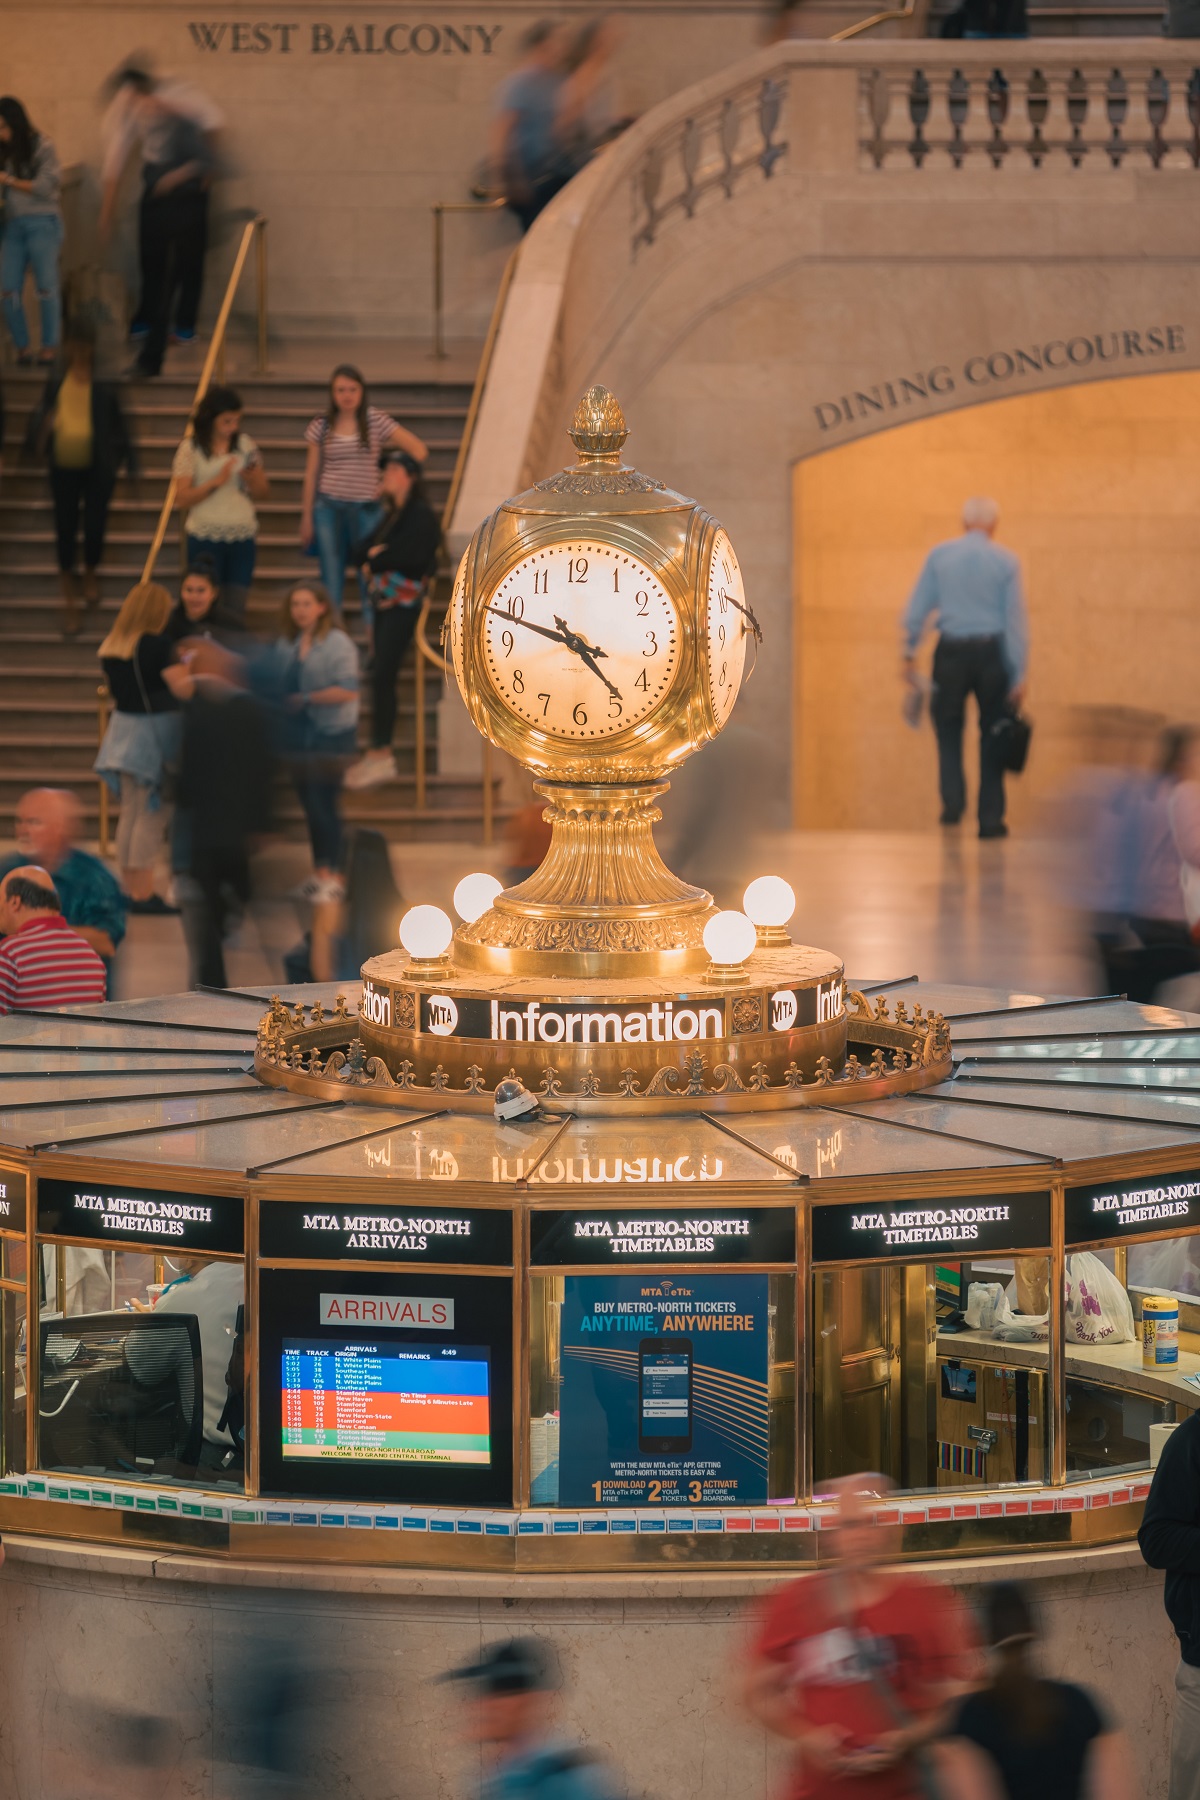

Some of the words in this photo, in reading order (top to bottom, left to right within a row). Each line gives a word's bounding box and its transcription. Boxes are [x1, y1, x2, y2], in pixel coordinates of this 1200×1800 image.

[188, 22, 298, 52] WEST
[311, 23, 502, 55] BALCONY
[812, 366, 955, 431] DINING
[964, 325, 1186, 386] CONCOURSE
[534, 570, 548, 594] 11
[567, 558, 588, 583] 12
[613, 568, 620, 593] 1
[508, 596, 524, 622] 10
[636, 591, 649, 616] 2
[502, 631, 513, 657] 9
[642, 631, 658, 656] 3
[513, 670, 525, 693] 8
[635, 669, 650, 692] 4
[538, 693, 550, 716] 7
[573, 702, 588, 725] 6
[608, 695, 623, 718] 5
[490, 1000, 722, 1042] Information
[74, 1194, 104, 1210] MTA
[107, 1198, 212, 1222] METRO-NORTH
[1092, 1195, 1120, 1212] MTA
[1117, 1201, 1189, 1224] TIMETABLES
[101, 1214, 184, 1236] TIMETABLES
[303, 1215, 340, 1230] MTA
[344, 1216, 470, 1235] METRO-NORTH
[574, 1222, 613, 1237] MTA
[617, 1220, 749, 1236] METRO-NORTH
[852, 1214, 886, 1230] MTA
[890, 1206, 1009, 1227] METRO-NORTH
[346, 1234, 427, 1250] ARRIVALS
[610, 1237, 714, 1252] TIMETABLES
[884, 1224, 978, 1245] TIMETABLES
[641, 1288, 662, 1296] MTA
[327, 1300, 447, 1324] ARRIVALS
[594, 1302, 614, 1313] BUY
[618, 1302, 692, 1313] METRO-NORTH
[694, 1302, 736, 1313] TICKETS
[580, 1316, 658, 1334] ANYTIME,
[662, 1315, 754, 1331] ANYWHERE
[1075, 1322, 1098, 1343] Thank
[1099, 1325, 1114, 1339] You
[592, 1480, 601, 1502] 1
[648, 1480, 661, 1502] 2
[688, 1480, 702, 1502] 3
[703, 1480, 738, 1488] ACTIVATE
